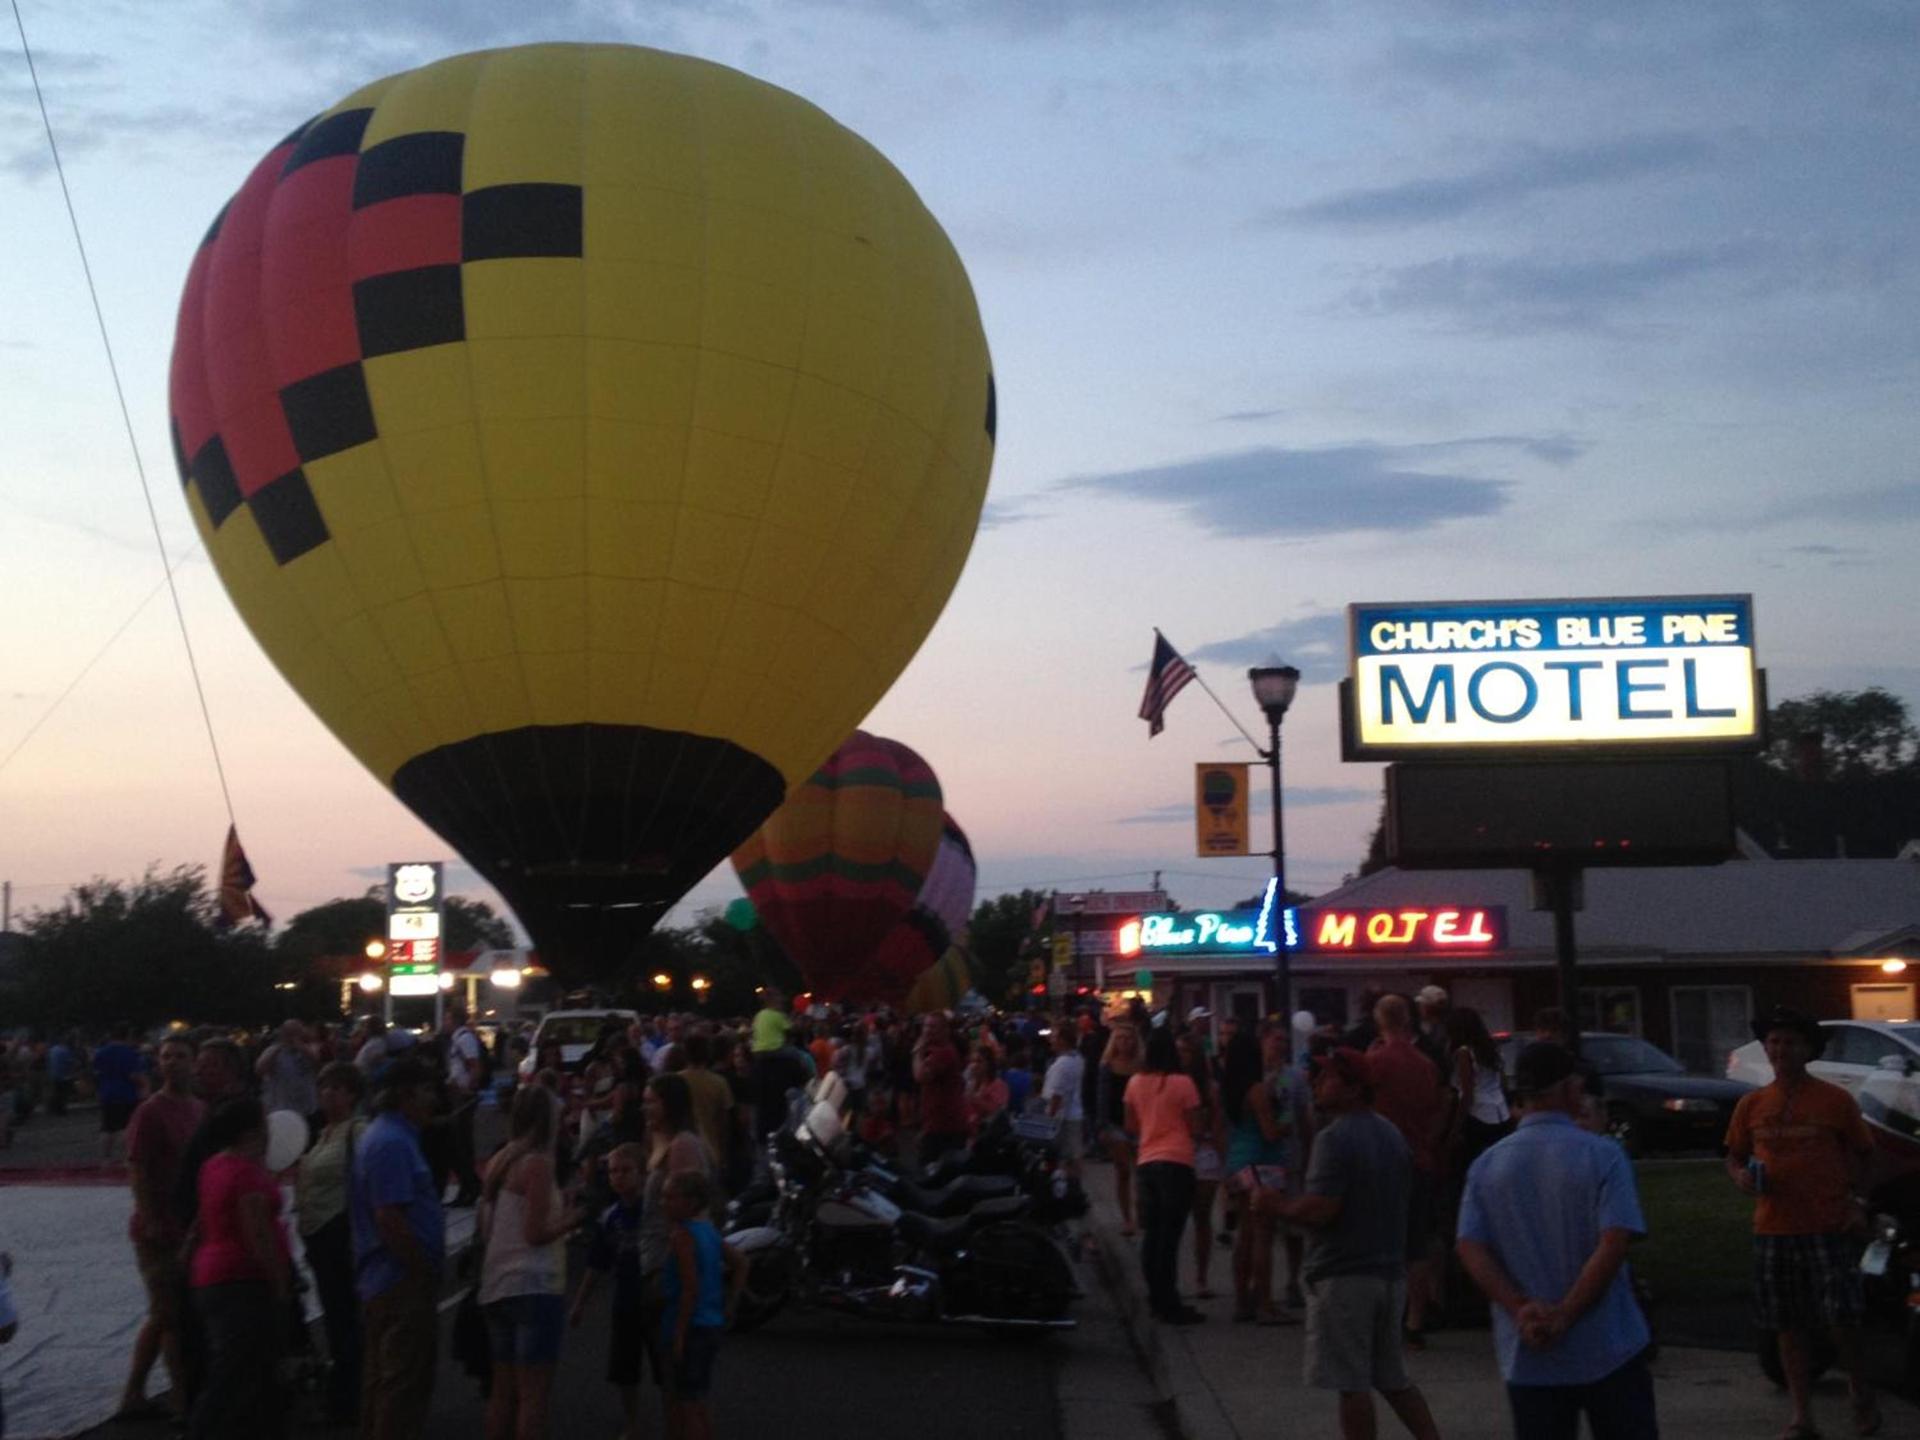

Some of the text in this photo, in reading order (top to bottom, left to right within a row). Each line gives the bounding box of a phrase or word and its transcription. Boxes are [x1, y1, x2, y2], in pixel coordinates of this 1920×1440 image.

[1370, 614, 1739, 651] CHURCH'S BLUE PINE
[1379, 658, 1737, 725] MOTEL
[1140, 915, 1195, 946] Blue
[1318, 911, 1493, 947] MOTEL
